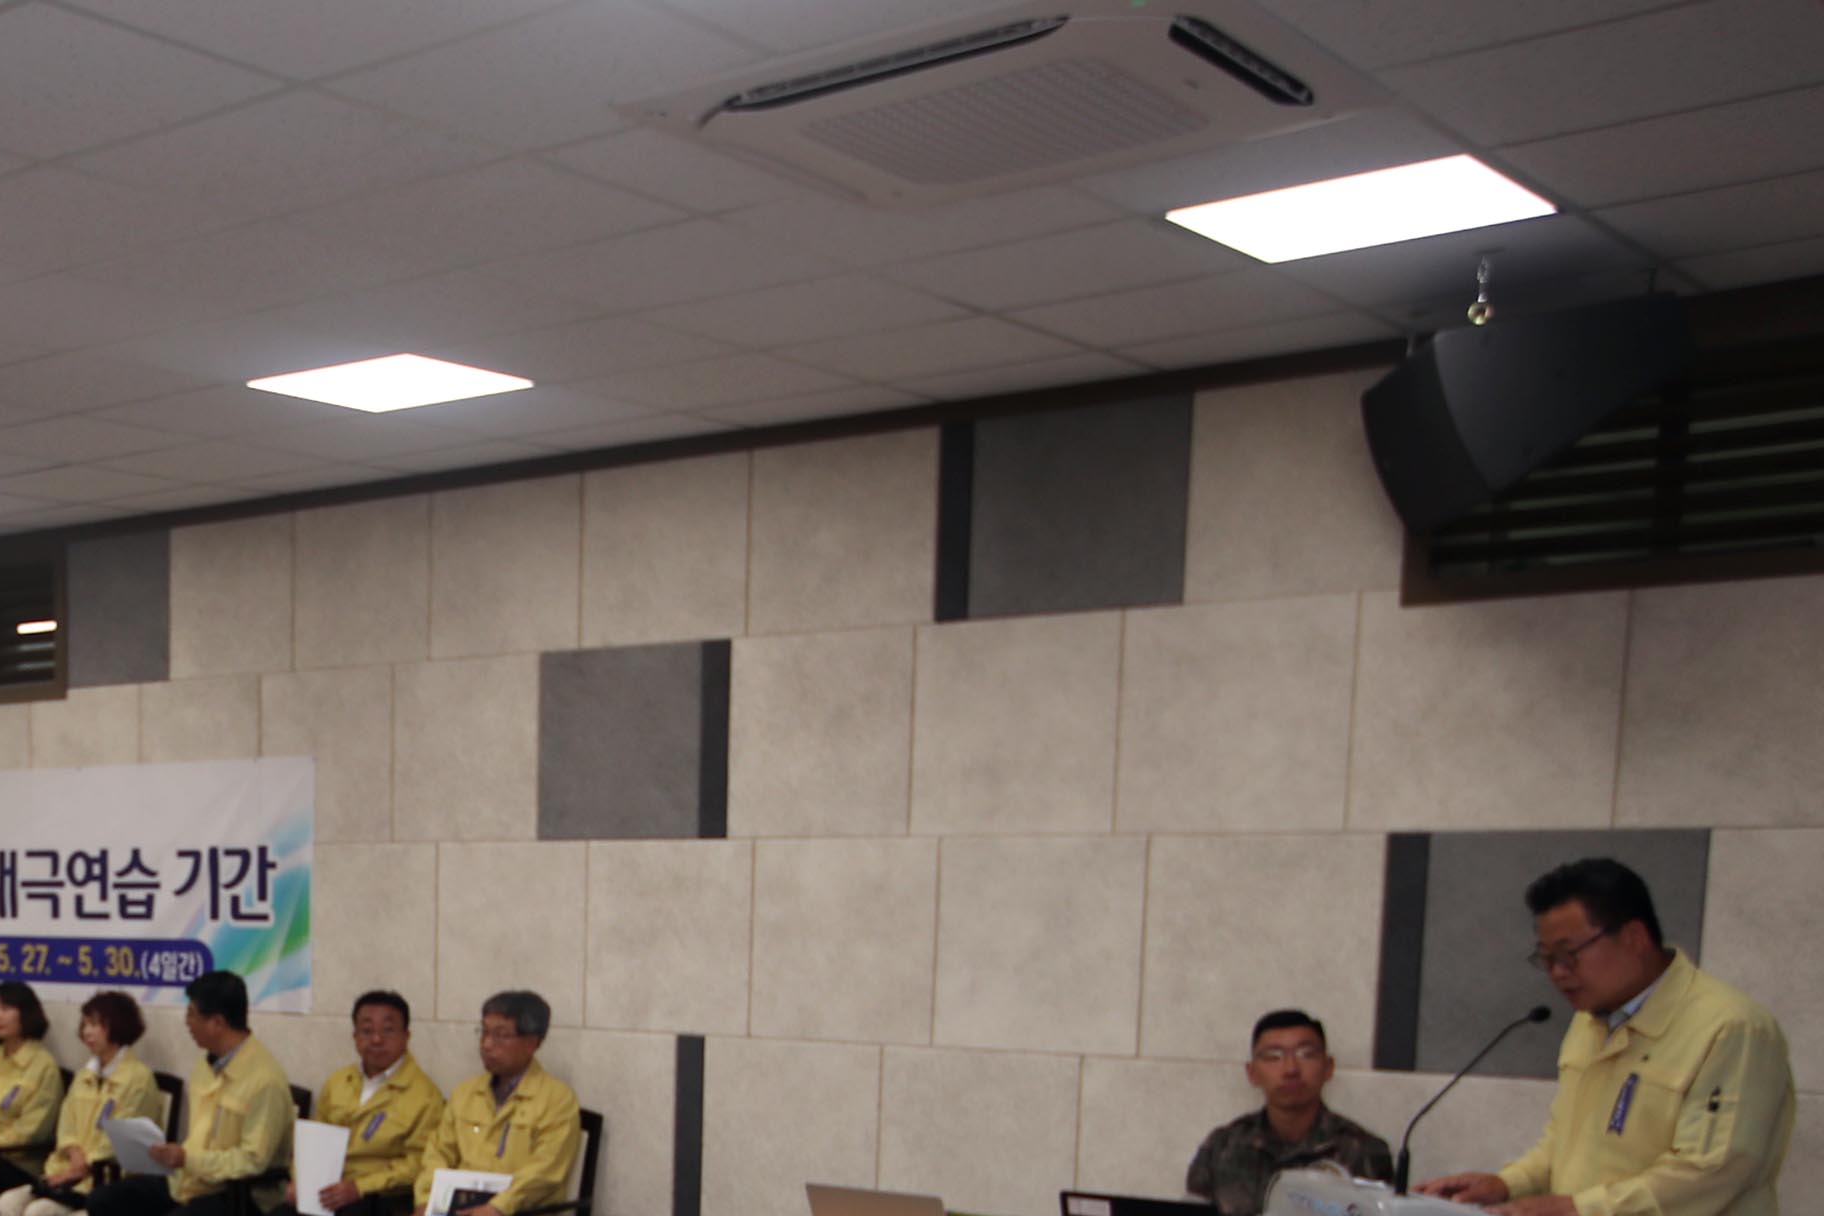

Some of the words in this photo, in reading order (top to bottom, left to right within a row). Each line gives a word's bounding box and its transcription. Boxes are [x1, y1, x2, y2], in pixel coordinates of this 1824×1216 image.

[173, 846, 277, 921] 기간
[21, 944, 52, 975] 27.
[78, 946, 99, 976] 5.
